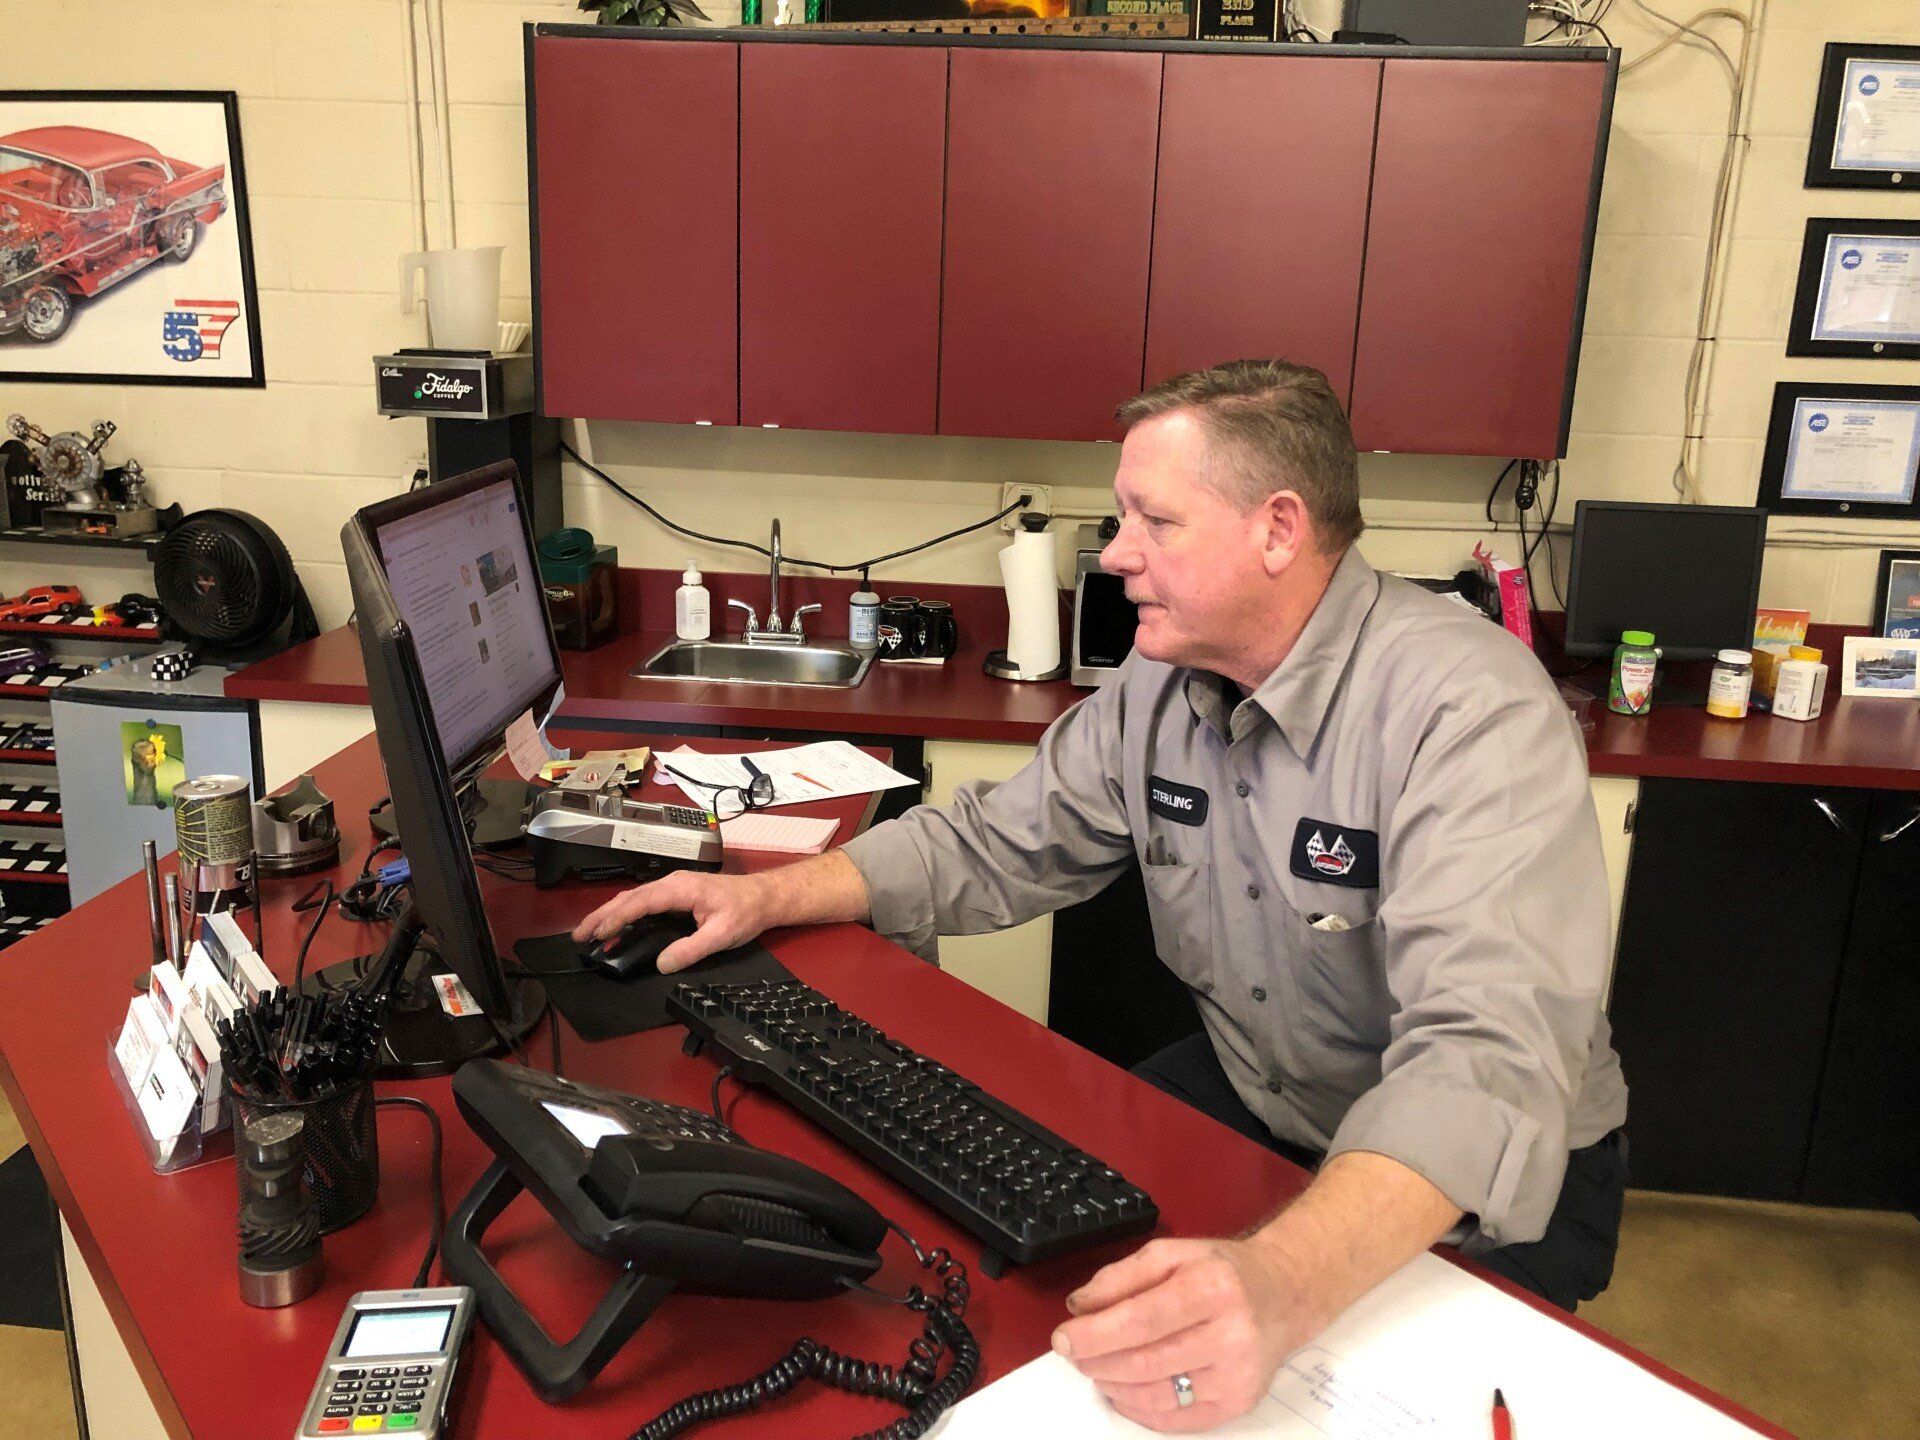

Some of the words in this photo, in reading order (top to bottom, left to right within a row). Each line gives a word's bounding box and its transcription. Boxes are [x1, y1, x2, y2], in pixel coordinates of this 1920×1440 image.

[1107, 1, 1147, 14] SECOND
[1150, 1, 1183, 14] PLACE
[1220, 15, 1254, 26] PLACE
[163, 299, 240, 362] 57
[421, 372, 474, 399] Fidalgo
[1152, 788, 1193, 811] STERLING
